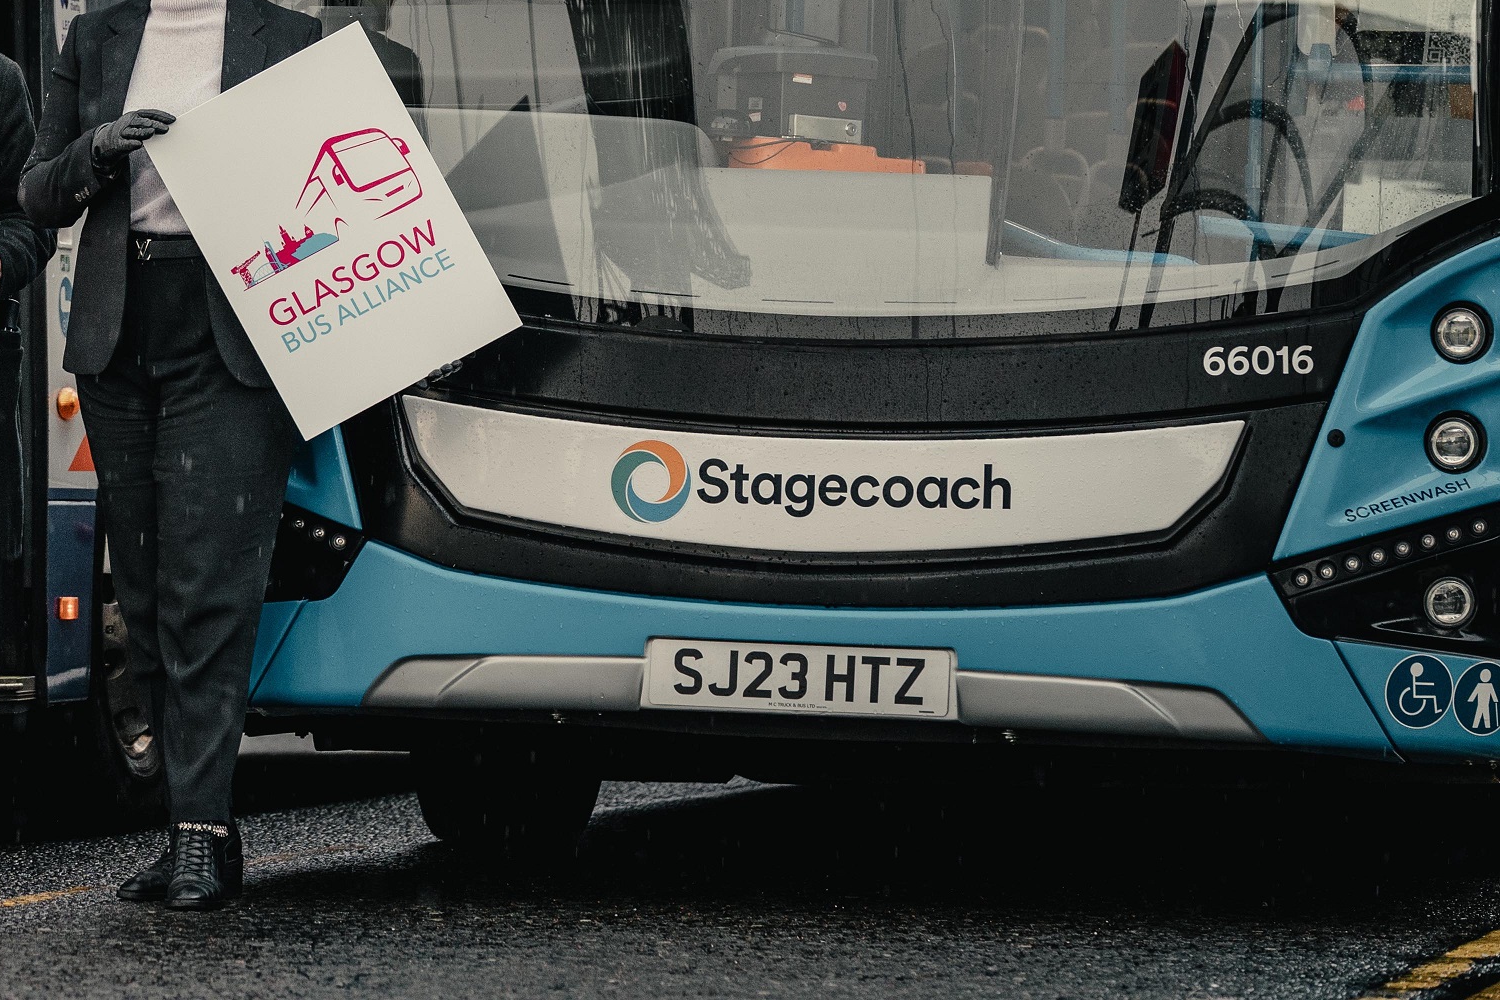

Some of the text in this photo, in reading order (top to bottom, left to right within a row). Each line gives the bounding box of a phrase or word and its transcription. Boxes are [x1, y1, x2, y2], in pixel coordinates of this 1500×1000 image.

[268, 218, 437, 327] GLASGOW
[280, 248, 456, 354] BUS ALLIANCE
[1203, 345, 1314, 376] 66016
[696, 458, 1013, 518] Stagecoach
[1344, 477, 1472, 523] SCREENWASH
[673, 648, 926, 706] SJ23 HTZ
